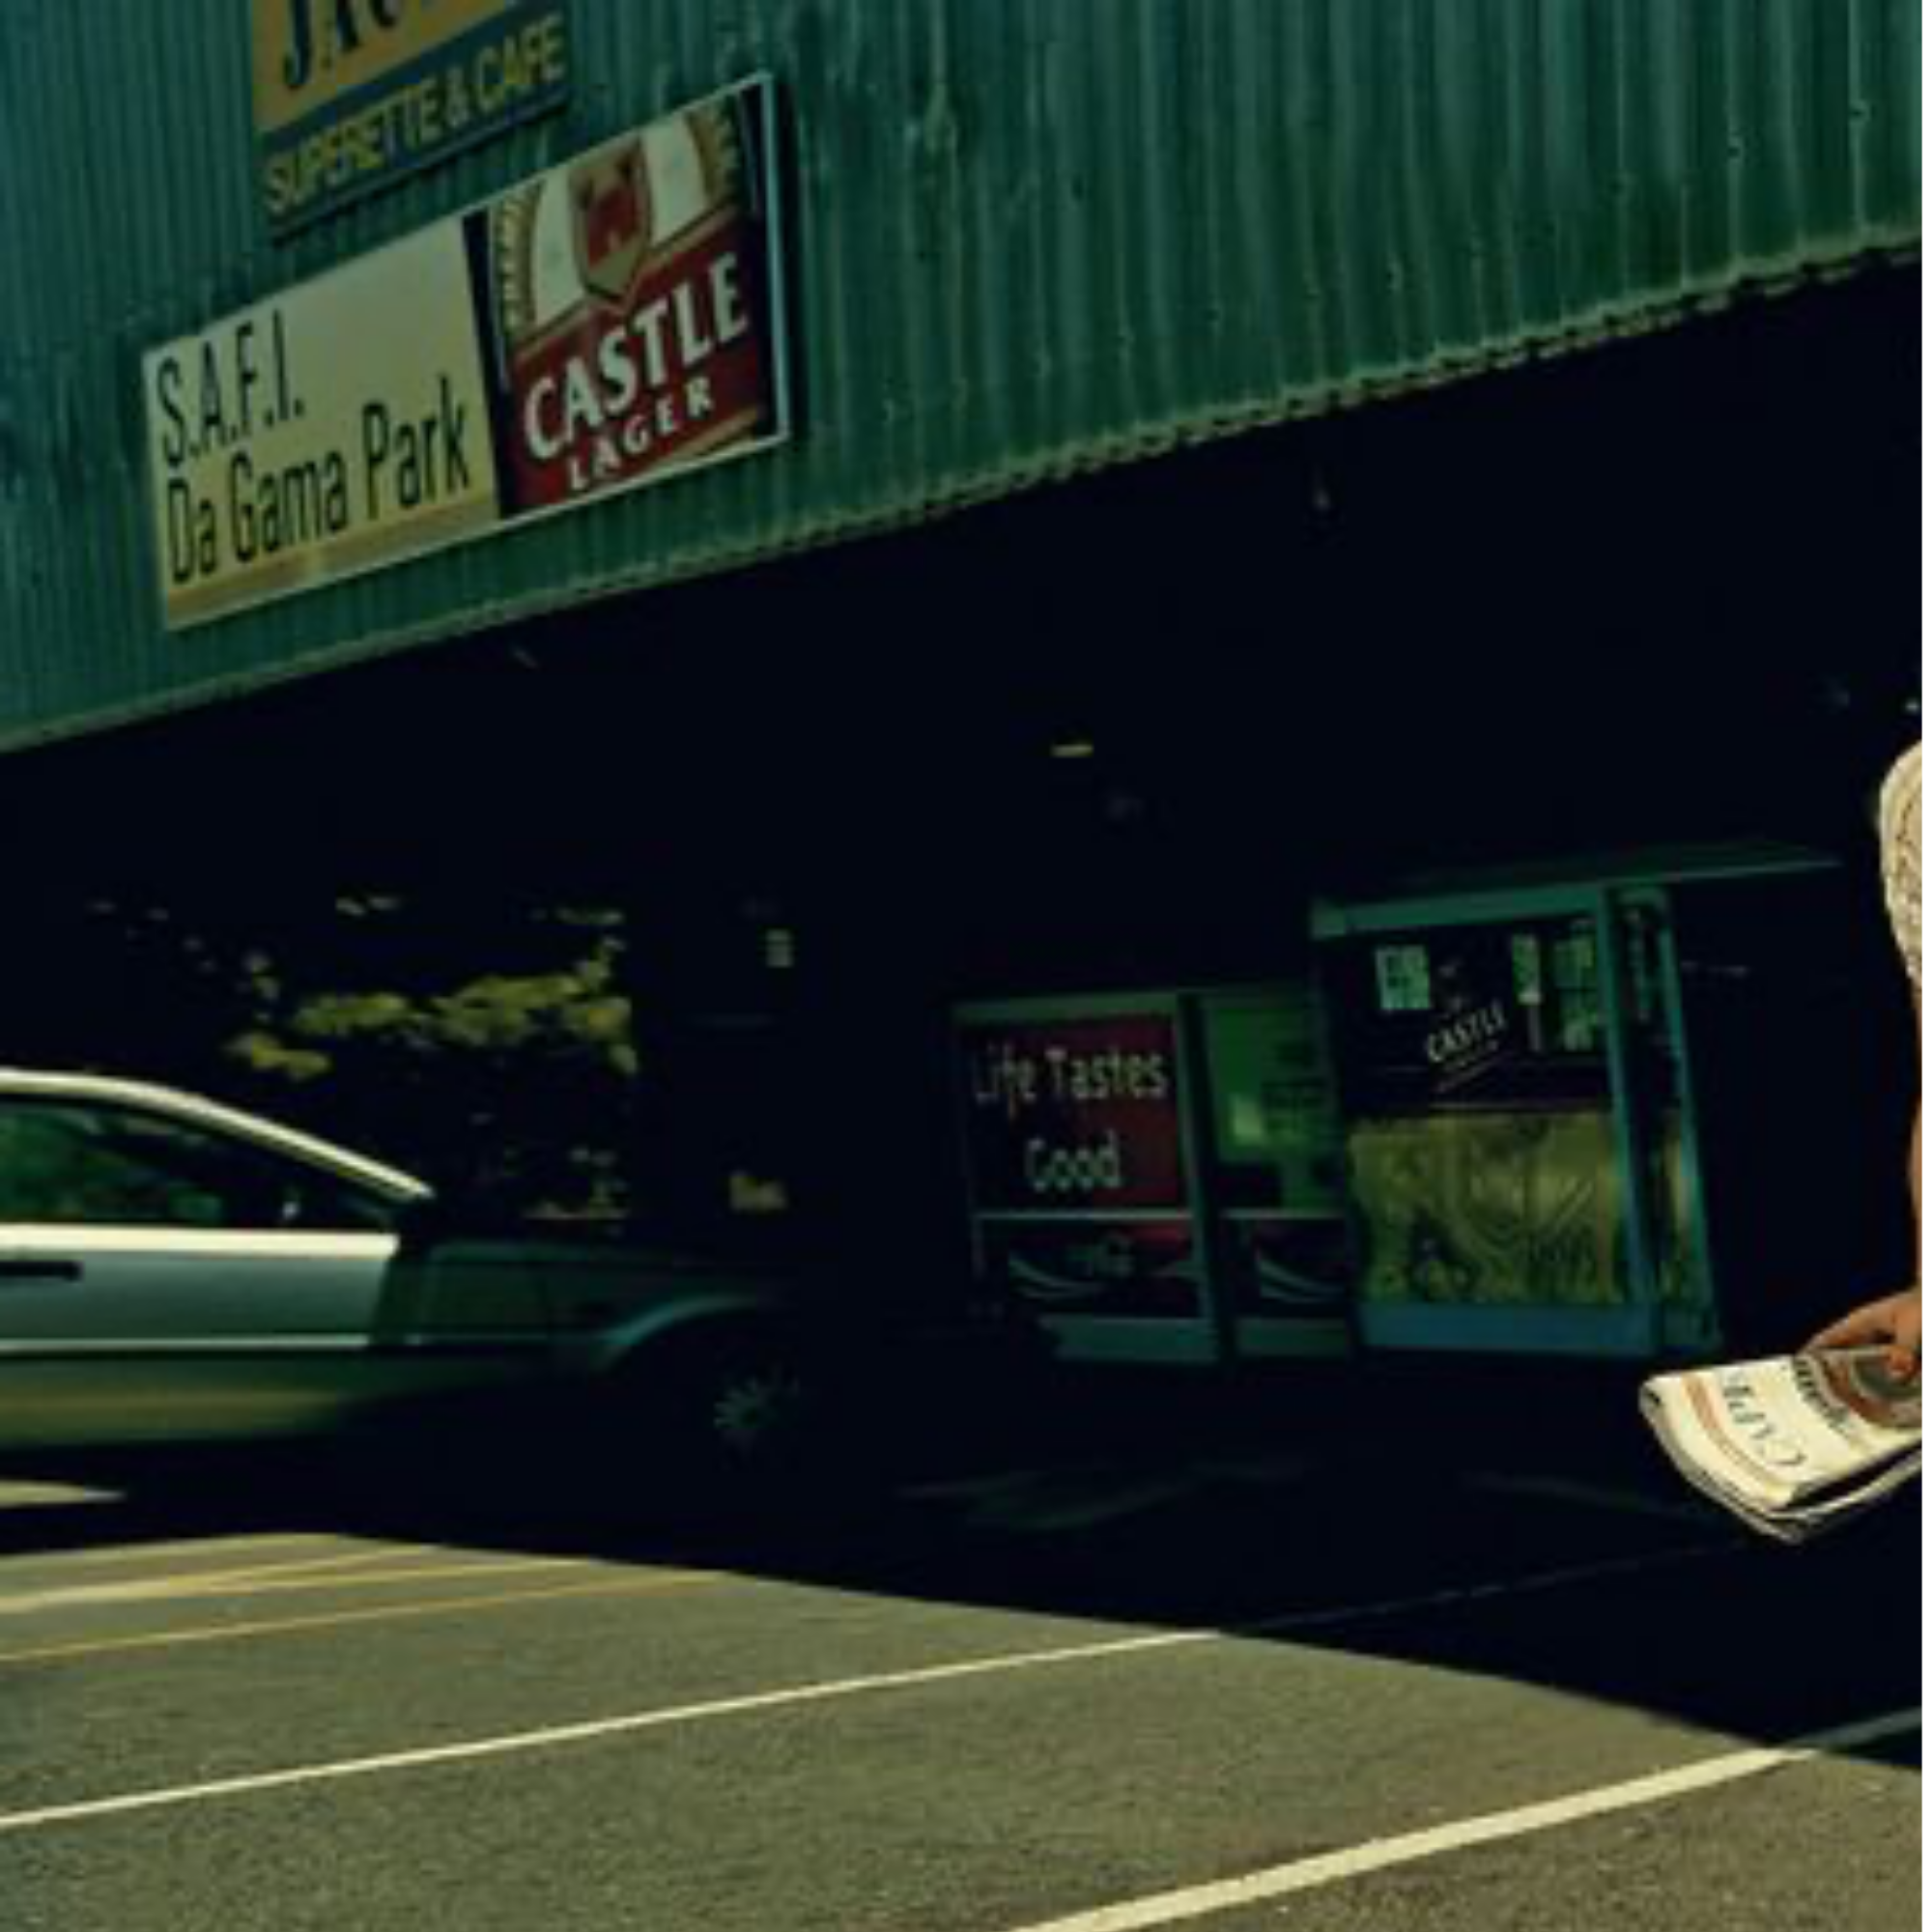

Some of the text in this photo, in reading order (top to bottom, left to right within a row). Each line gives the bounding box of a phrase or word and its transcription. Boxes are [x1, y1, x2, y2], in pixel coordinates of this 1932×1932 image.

[157, 309, 305, 467] S.A.F.I.
[524, 250, 750, 460] CASTLE
[167, 375, 470, 583] Da Gama Park
[568, 376, 715, 491] LAGER
[972, 1038, 1170, 1121] Life Tastes
[1022, 1128, 1122, 1195] Good
